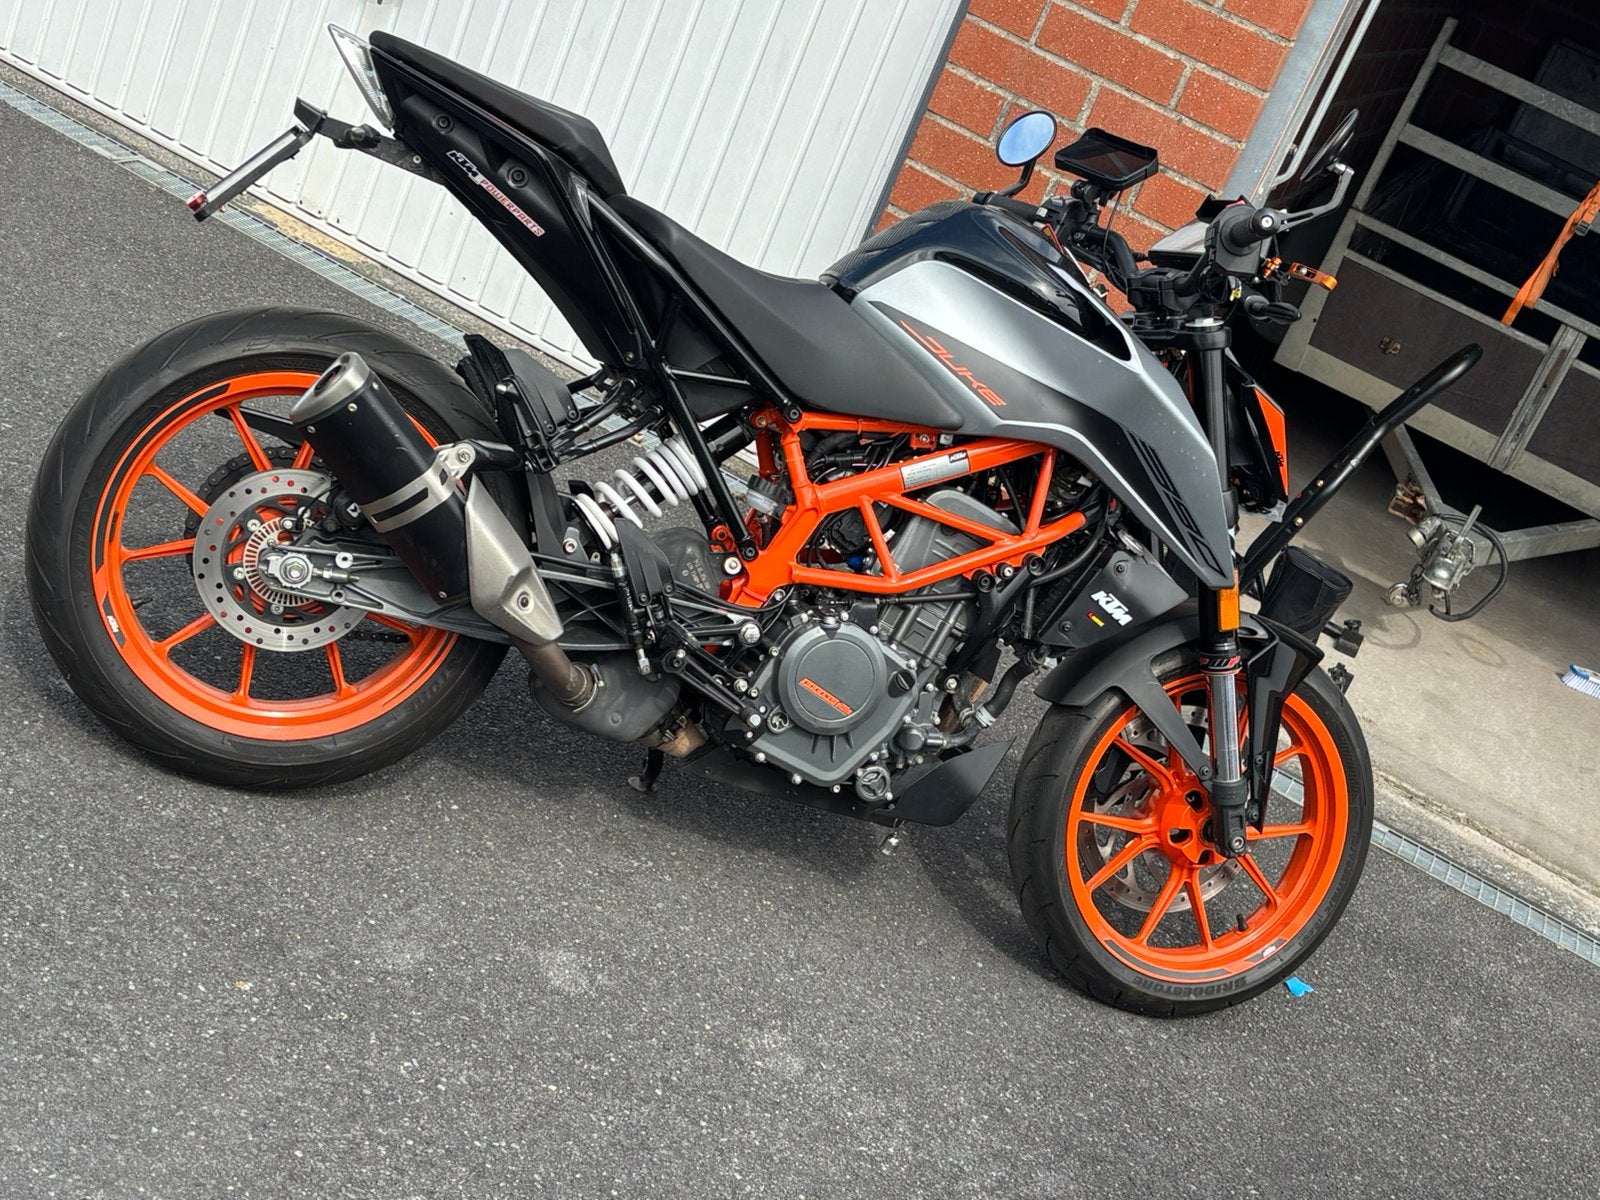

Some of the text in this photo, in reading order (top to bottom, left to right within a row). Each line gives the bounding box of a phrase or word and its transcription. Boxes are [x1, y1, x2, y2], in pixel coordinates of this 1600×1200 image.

[446, 150, 544, 236] KTM POWERPARTS
[900, 319, 1007, 406] DUKE
[1127, 430, 1228, 579] 390
[1090, 590, 1133, 626] KTM
